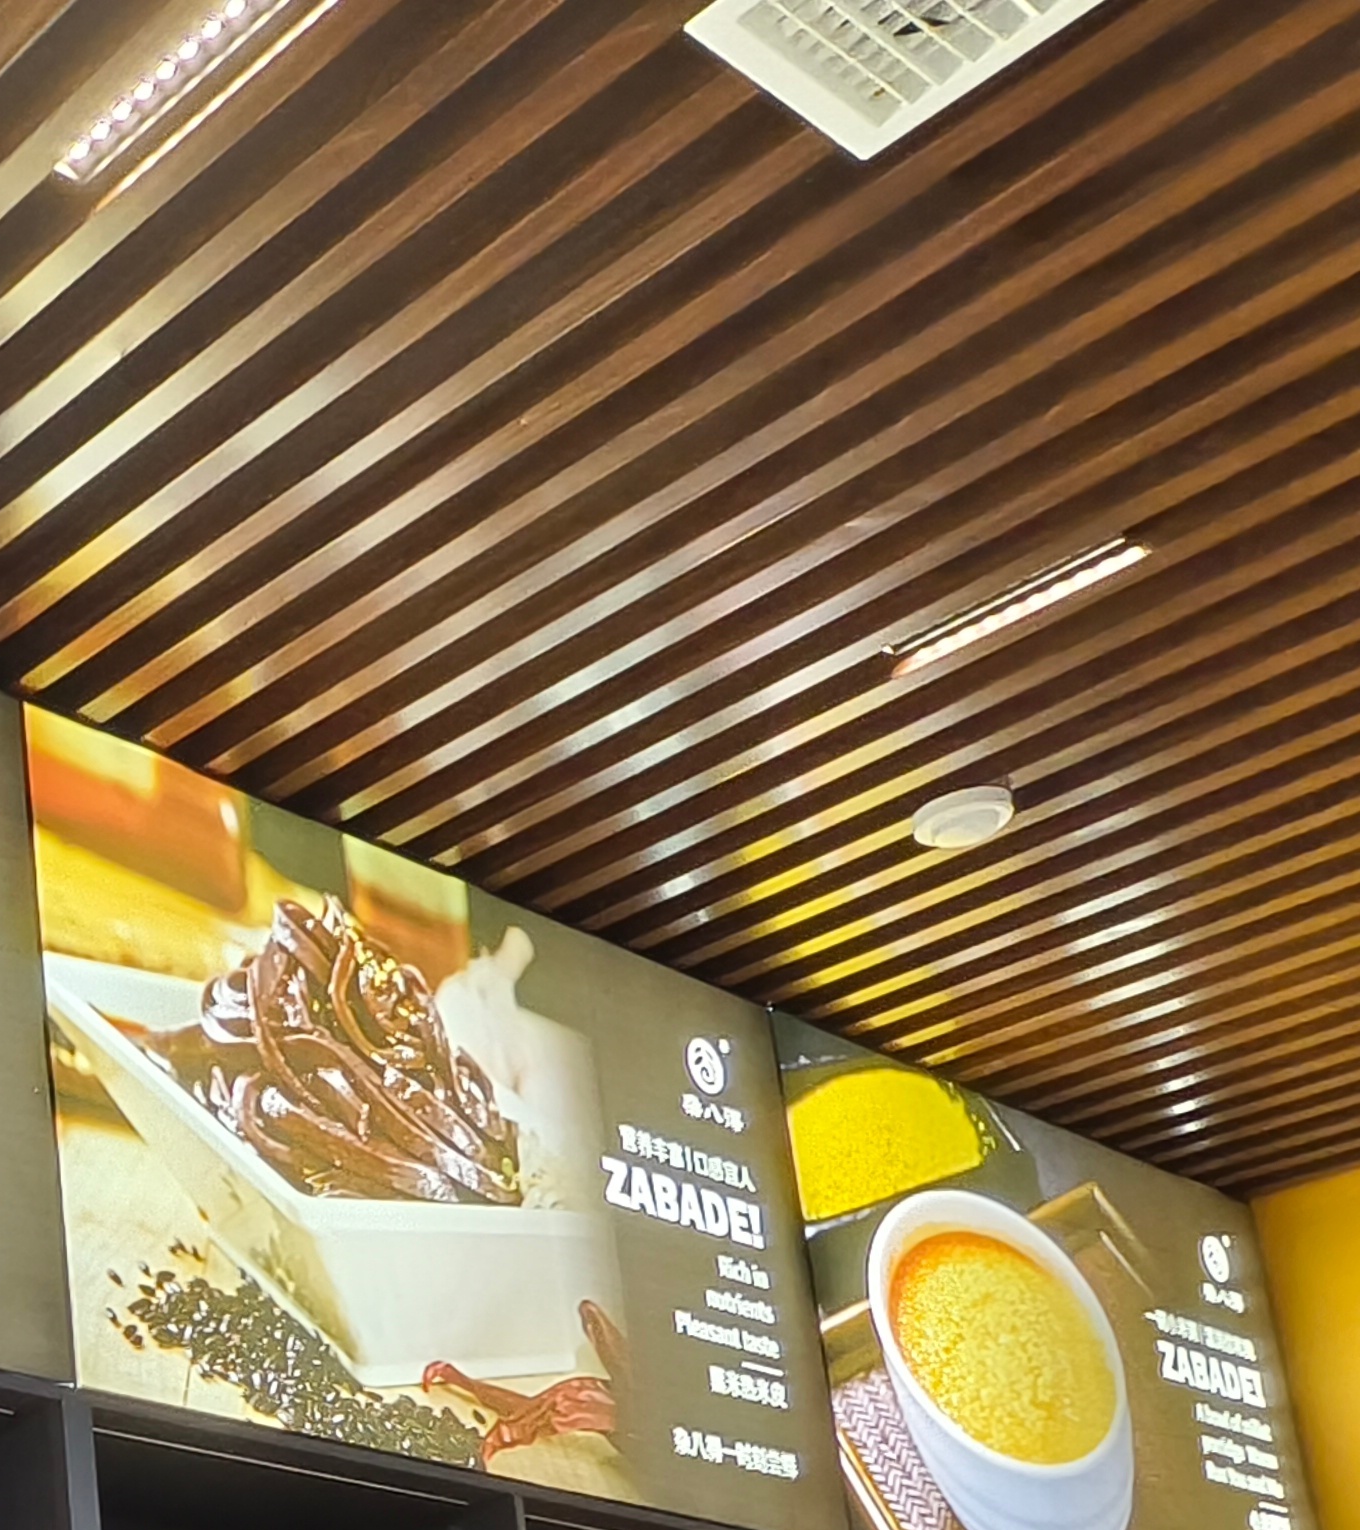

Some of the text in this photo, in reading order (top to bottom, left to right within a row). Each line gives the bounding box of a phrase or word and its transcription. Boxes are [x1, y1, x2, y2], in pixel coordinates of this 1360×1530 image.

[600, 1156, 765, 1249] ZABADE!
[674, 1310, 781, 1359] Pleasant taste
